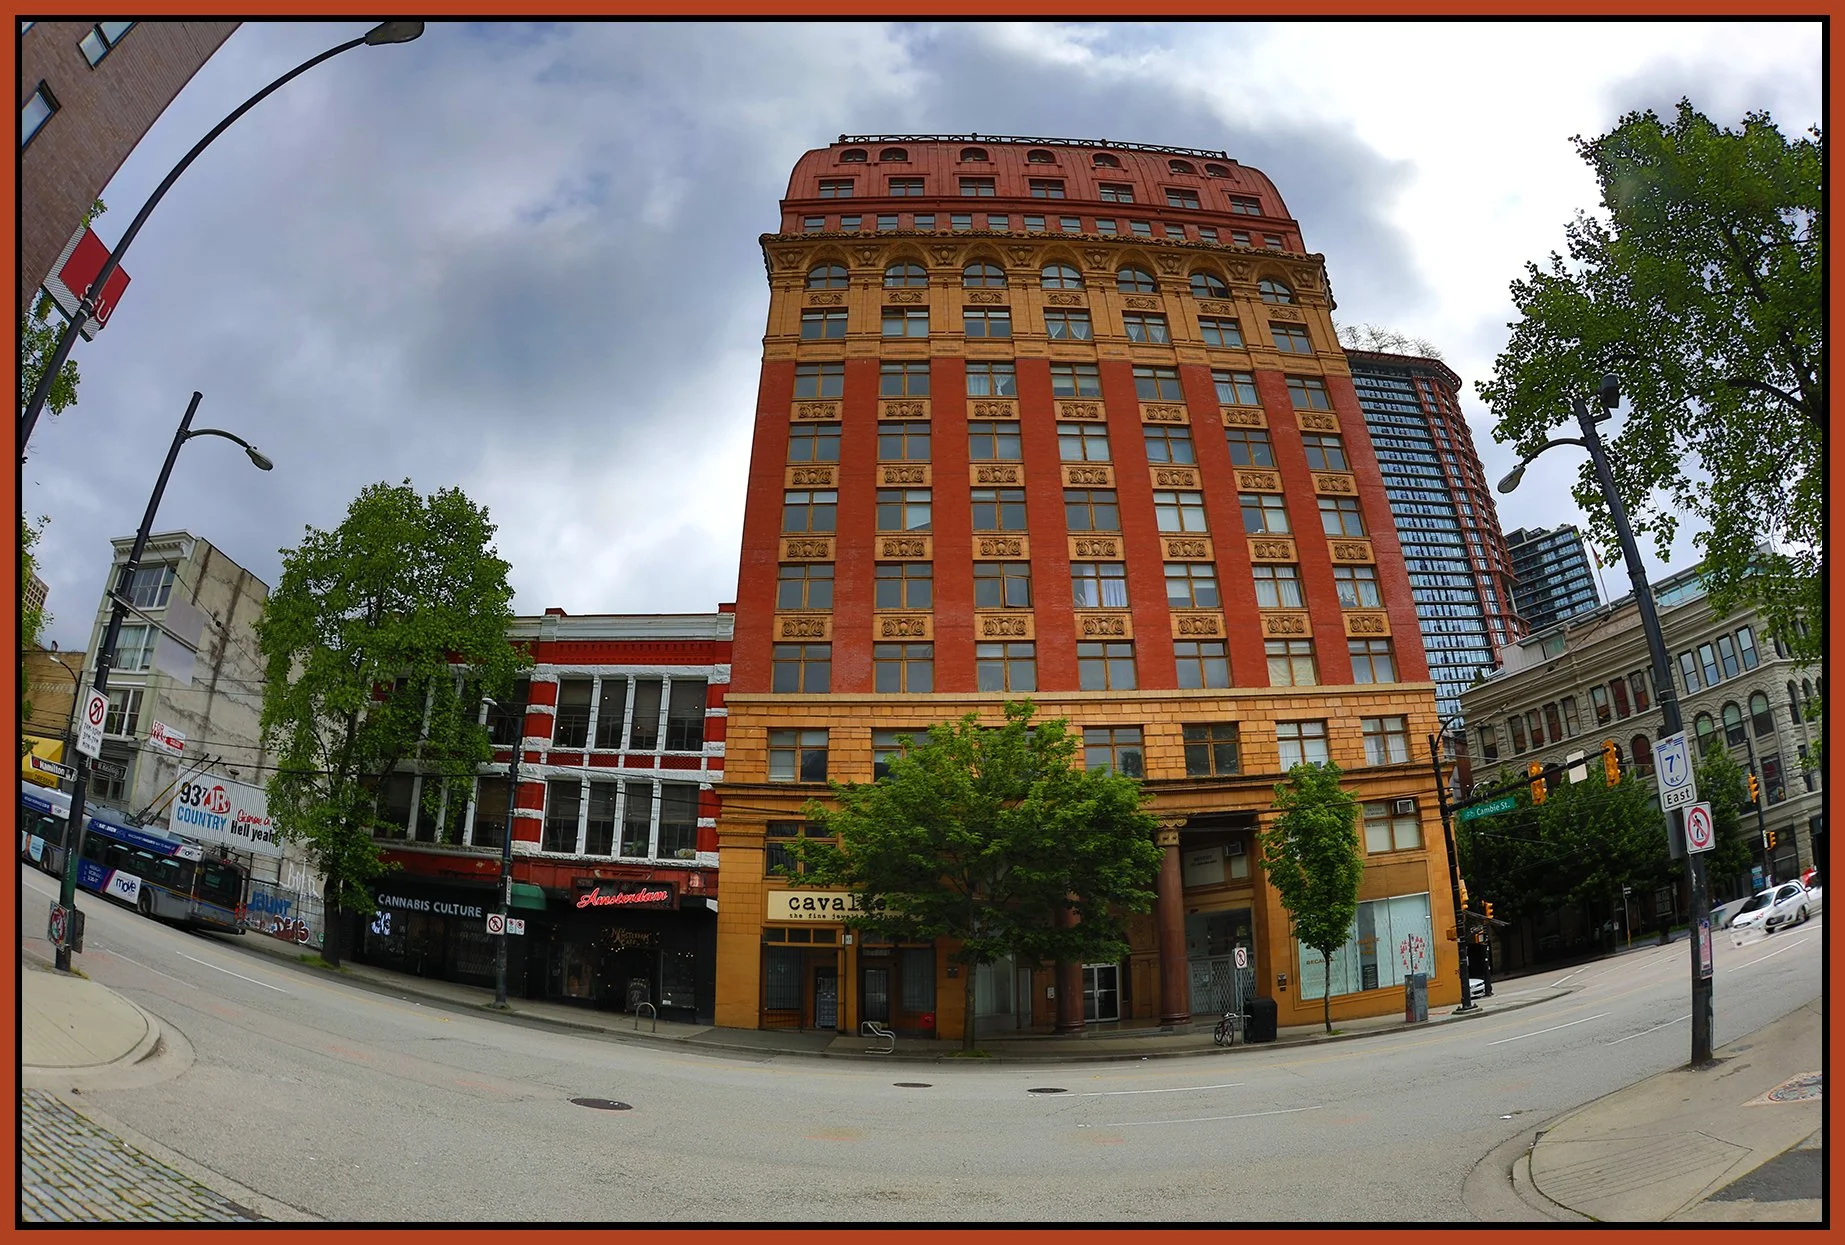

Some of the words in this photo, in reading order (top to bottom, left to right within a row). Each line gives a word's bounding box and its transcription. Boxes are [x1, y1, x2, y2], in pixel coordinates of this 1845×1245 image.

[39, 760, 66, 777] Hamilton
[1667, 788, 1691, 805] East
[1476, 804, 1500, 816] Cambie
[1501, 801, 1511, 810] St.
[177, 806, 228, 832] COUNTRY
[230, 820, 250, 838] Hell
[115, 876, 137, 894] move
[378, 893, 431, 912] CANNABIS
[433, 901, 483, 919] CULTURE
[576, 887, 668, 909] Amsterdam
